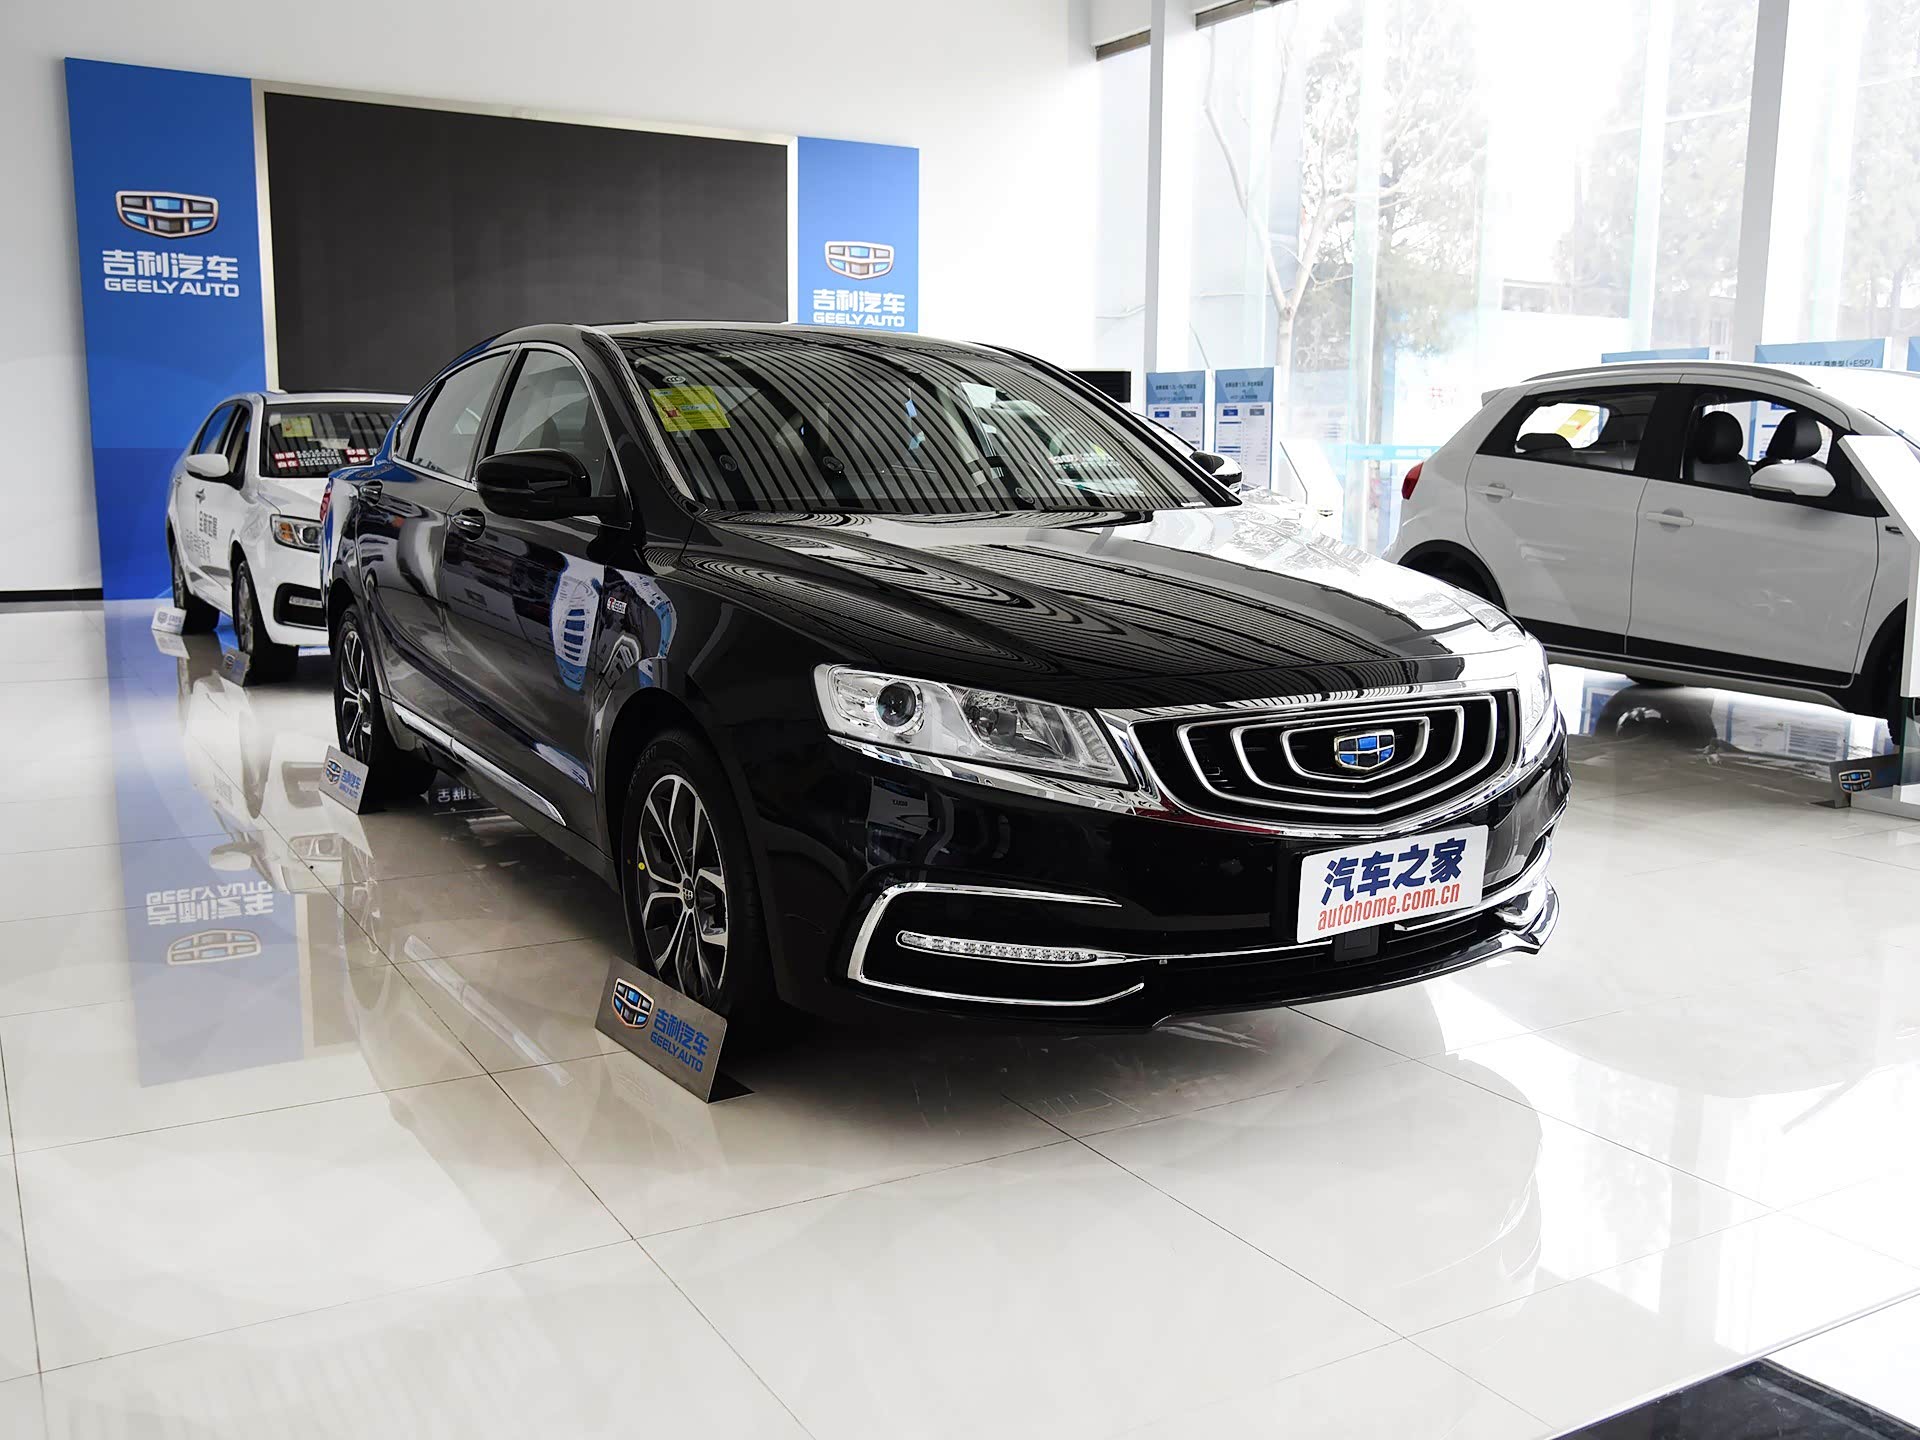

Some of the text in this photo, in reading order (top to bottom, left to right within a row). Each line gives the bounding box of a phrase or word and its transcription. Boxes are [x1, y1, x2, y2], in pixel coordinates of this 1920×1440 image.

[102, 249, 239, 281] 吉利汽车
[104, 278, 240, 297] GEELY AUTO
[813, 289, 905, 314] 吉利汽车
[813, 312, 905, 327] GEELY AUTO
[1320, 837, 1467, 906] 汽车之家
[1317, 883, 1461, 931] autohome.com.cn
[653, 1007, 710, 1057] 吉利汽车
[650, 1031, 704, 1073] GEELY AUTO
